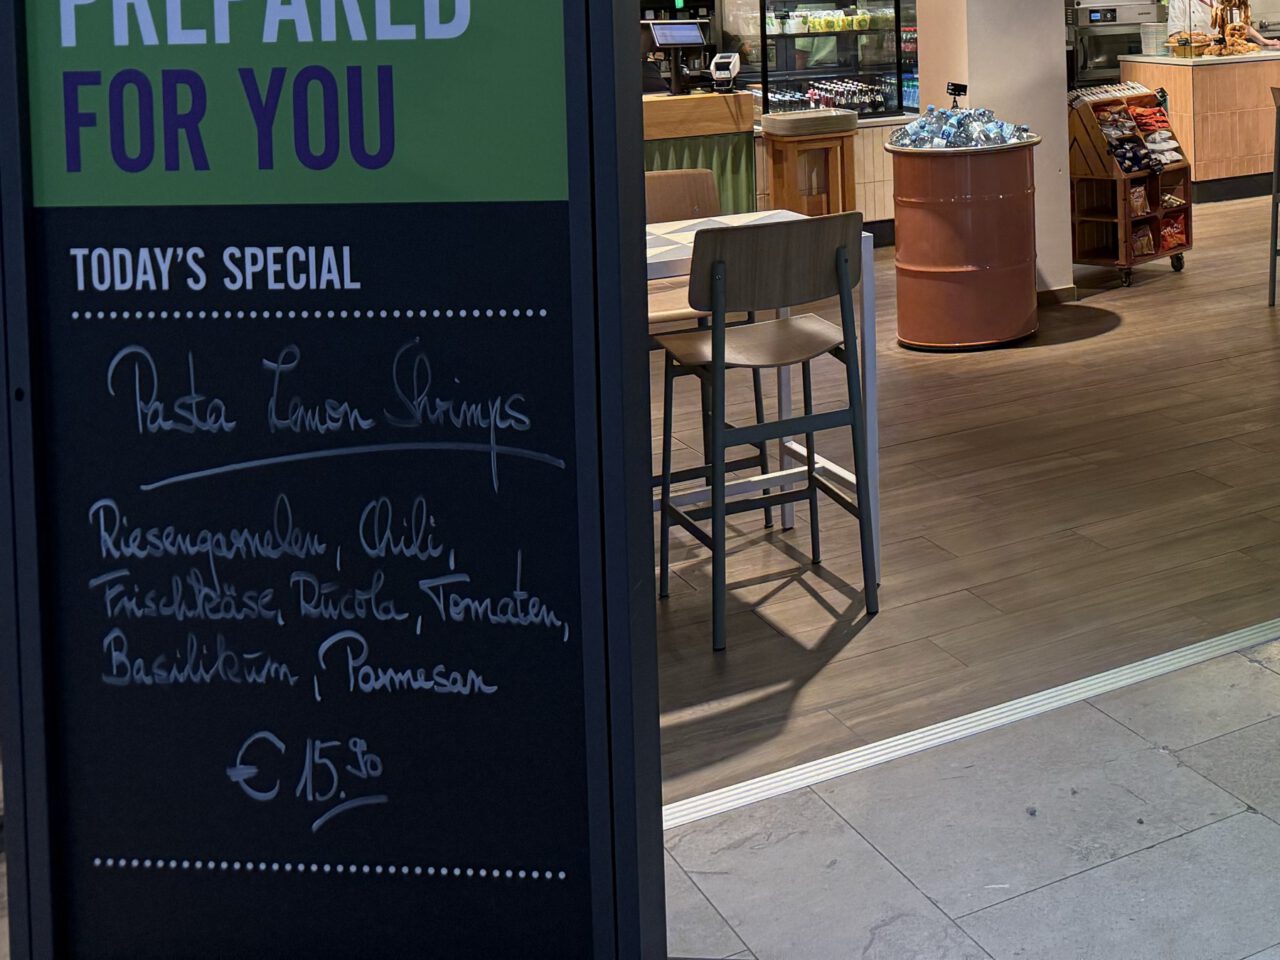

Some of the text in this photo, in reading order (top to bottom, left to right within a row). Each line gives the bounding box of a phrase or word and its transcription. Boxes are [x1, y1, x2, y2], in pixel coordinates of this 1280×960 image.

[62, 64, 397, 174] FOR YOU
[70, 246, 361, 293] TODAY'S SPECIAL
[106, 336, 533, 493] Pasta Lemon Shrimps
[318, 629, 499, 695] Parmesan
